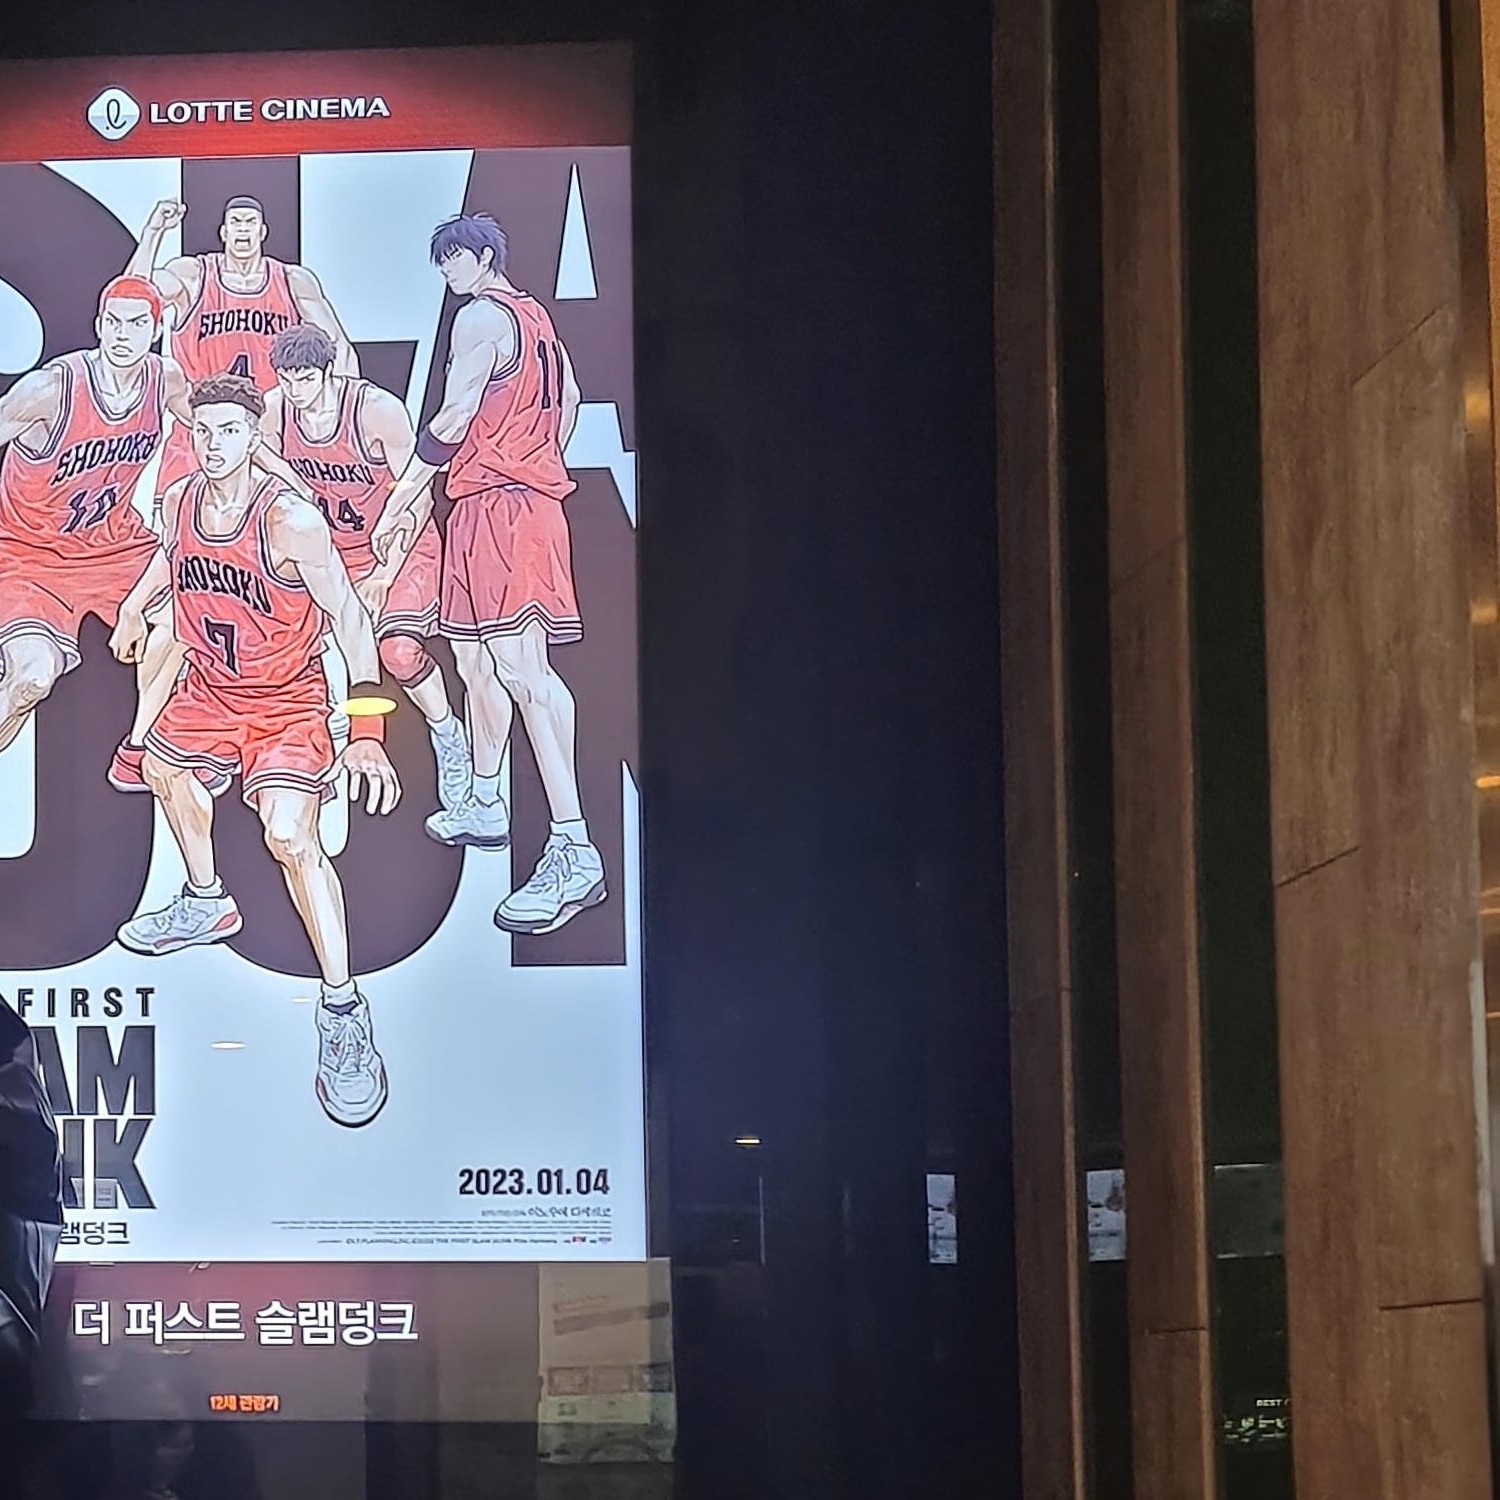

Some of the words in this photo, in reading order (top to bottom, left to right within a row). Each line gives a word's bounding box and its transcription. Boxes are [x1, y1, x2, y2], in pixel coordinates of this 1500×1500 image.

[150, 101, 253, 124] LOTTE
[261, 97, 390, 120] CINEMA
[203, 615, 240, 675] 7
[17, 987, 156, 1018] FIRST
[458, 1167, 611, 1196] 2023.01.04
[73, 1300, 111, 1346] 더
[124, 1300, 246, 1346] 퍼스트
[255, 1299, 420, 1346] 슬램덩크
